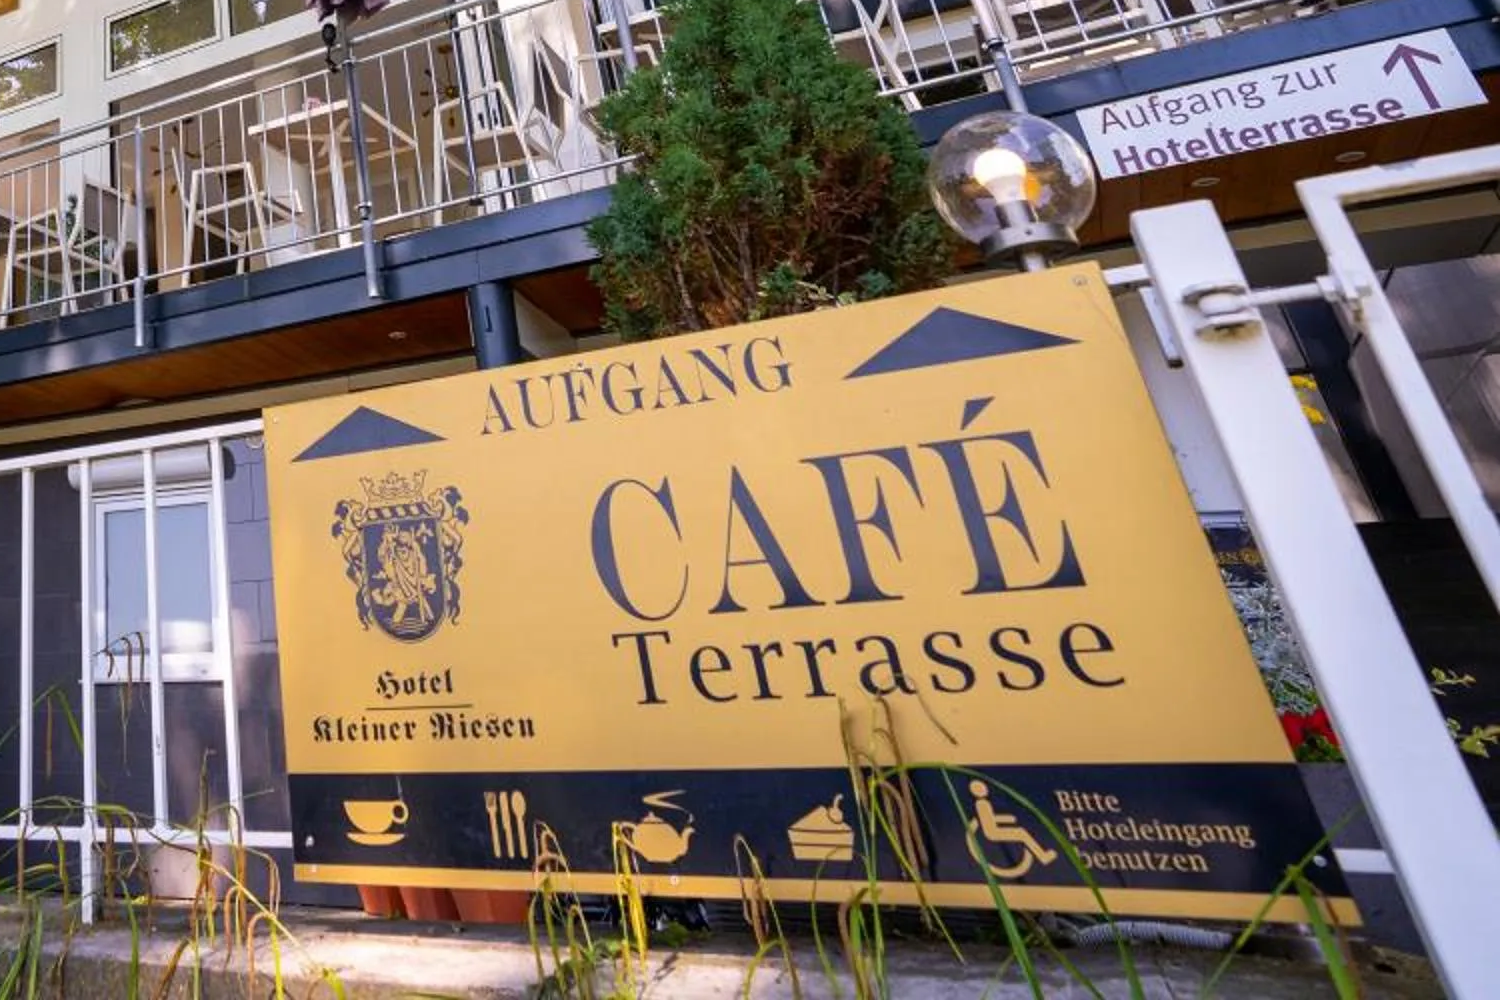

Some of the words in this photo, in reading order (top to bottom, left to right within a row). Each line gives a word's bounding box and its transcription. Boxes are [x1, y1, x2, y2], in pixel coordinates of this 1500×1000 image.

[1100, 78, 1265, 136] Aufgang
[1271, 60, 1338, 97] zur
[1112, 97, 1407, 176] Hotelterrasse
[480, 335, 795, 436] AUFGANG
[590, 396, 1088, 622] CAFÉ
[375, 667, 454, 700] Hotel
[611, 620, 1126, 706] Terrasse
[312, 713, 418, 743] Kleiner
[428, 711, 536, 740] Riesen
[1054, 789, 1122, 813] Bitte
[1062, 817, 1257, 848] Hoteleingang
[1077, 845, 1210, 873] benutzen
